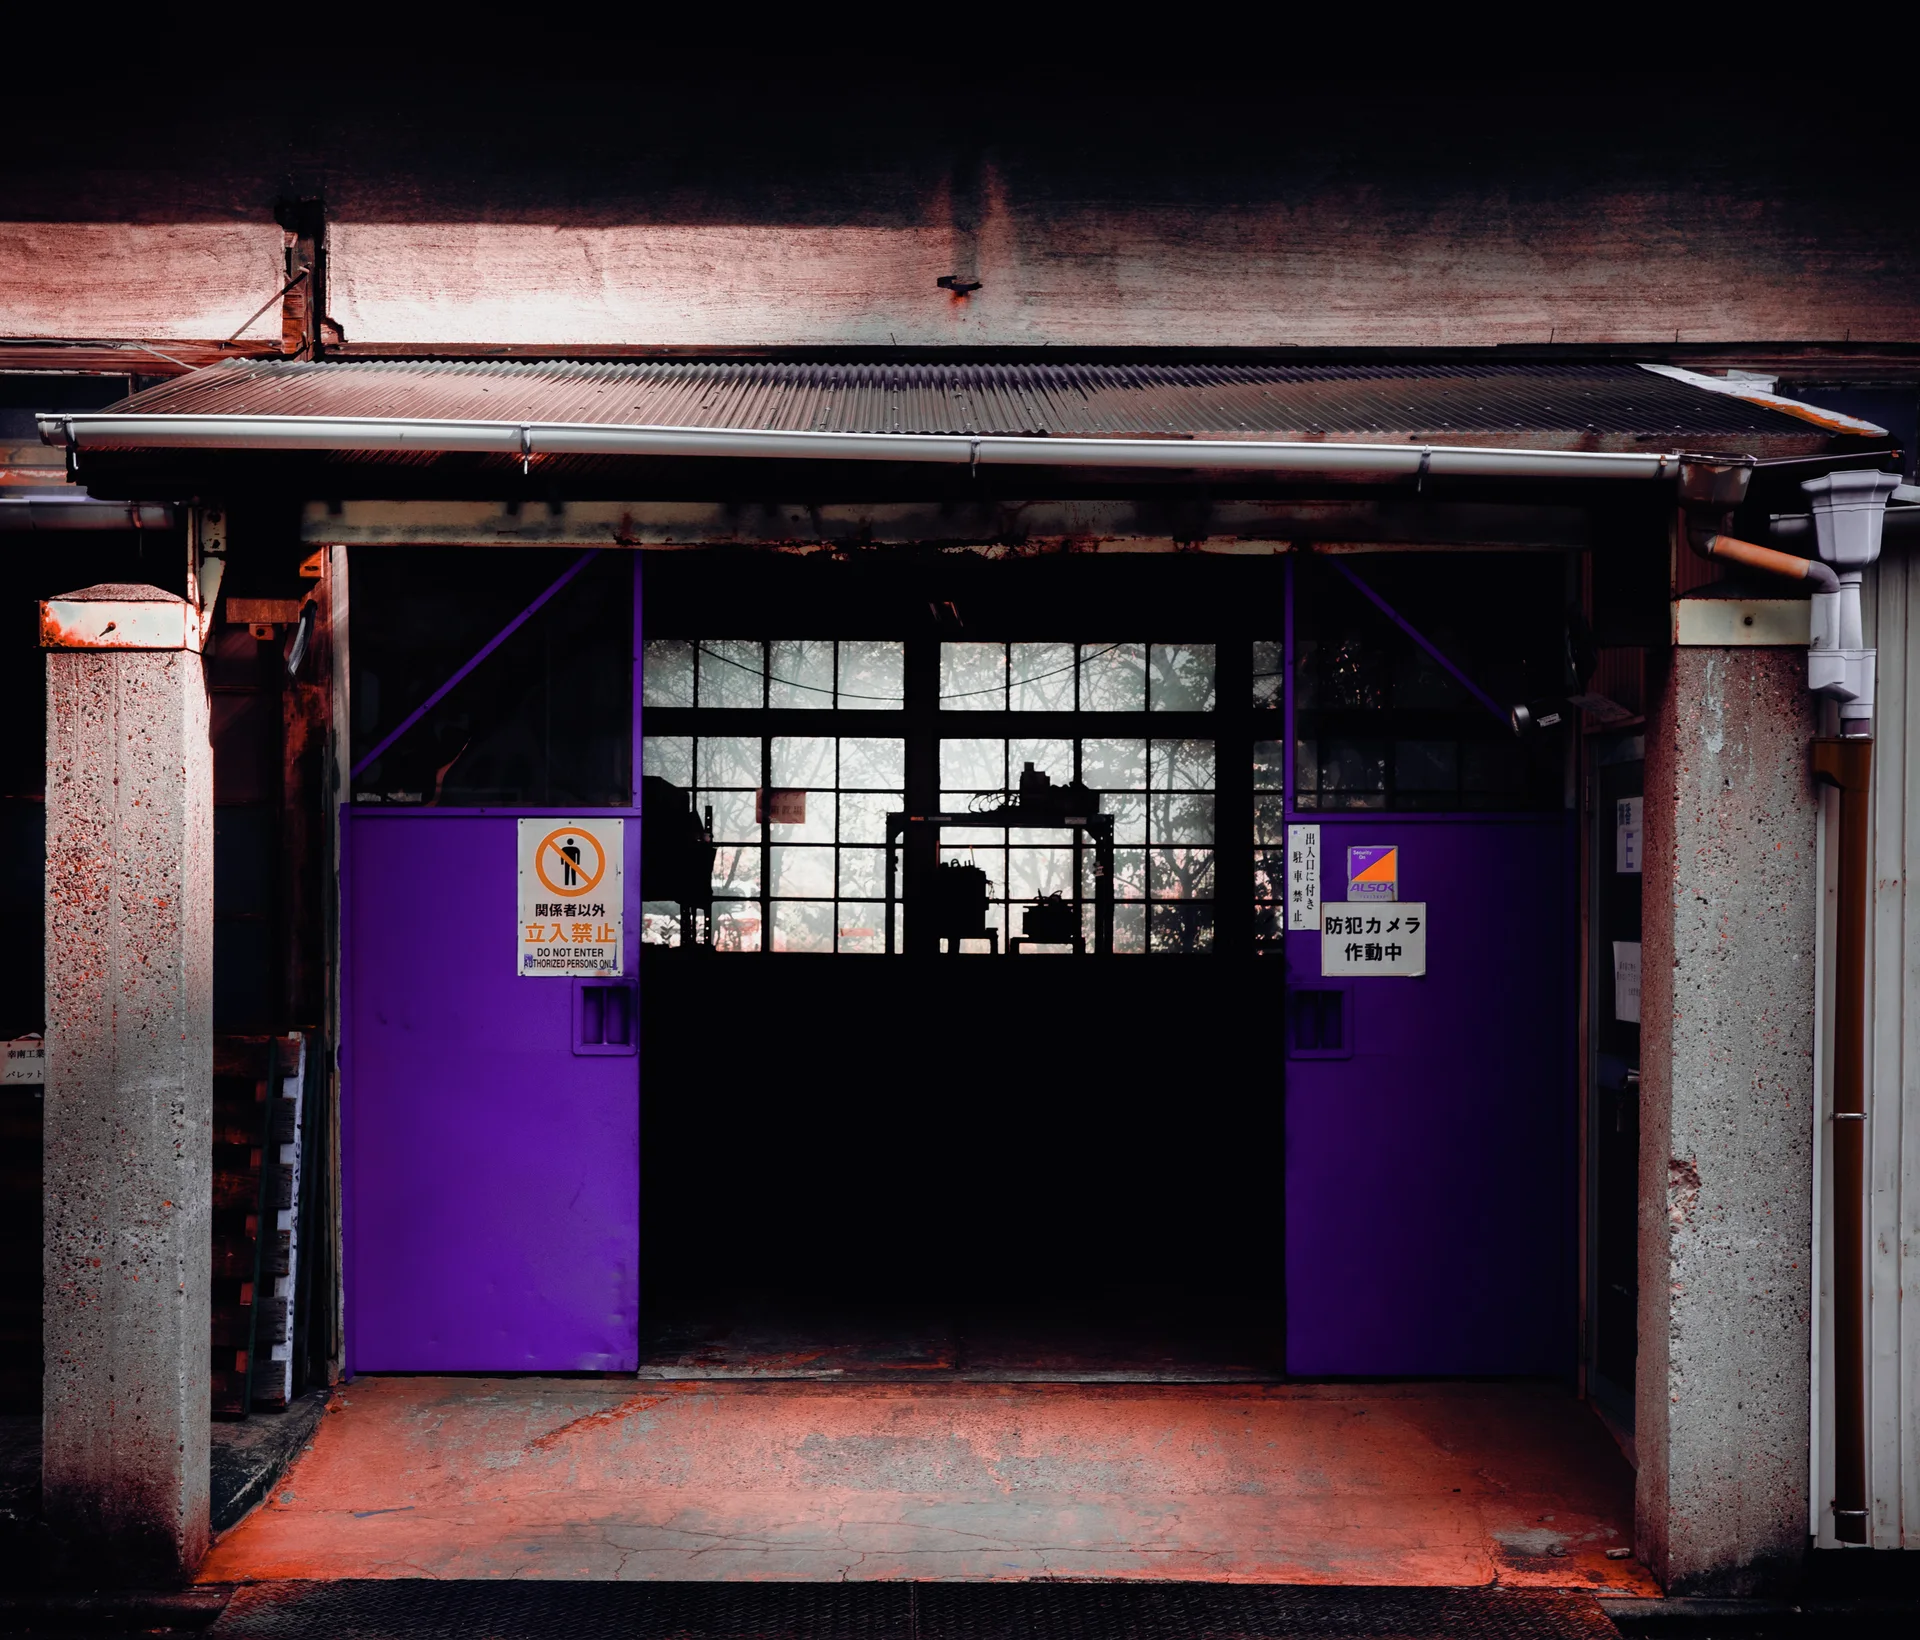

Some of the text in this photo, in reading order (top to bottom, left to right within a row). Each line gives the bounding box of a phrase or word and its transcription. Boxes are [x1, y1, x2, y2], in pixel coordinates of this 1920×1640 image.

[1305, 832, 1316, 910] 出入口に付き
[1292, 851, 1303, 923] 駐車禁止
[1349, 883, 1395, 893] ALSOK
[535, 903, 606, 918] 関係者以外
[525, 922, 617, 944] 立入禁止
[1325, 916, 1421, 935] 防犯カメラ
[537, 948, 604, 958] DO NOT ENTER
[1344, 942, 1403, 962] 作動中
[524, 959, 565, 968] AUTHORIZED
[567, 959, 598, 968] PERSONS
[6, 1070, 42, 1078] パレット
